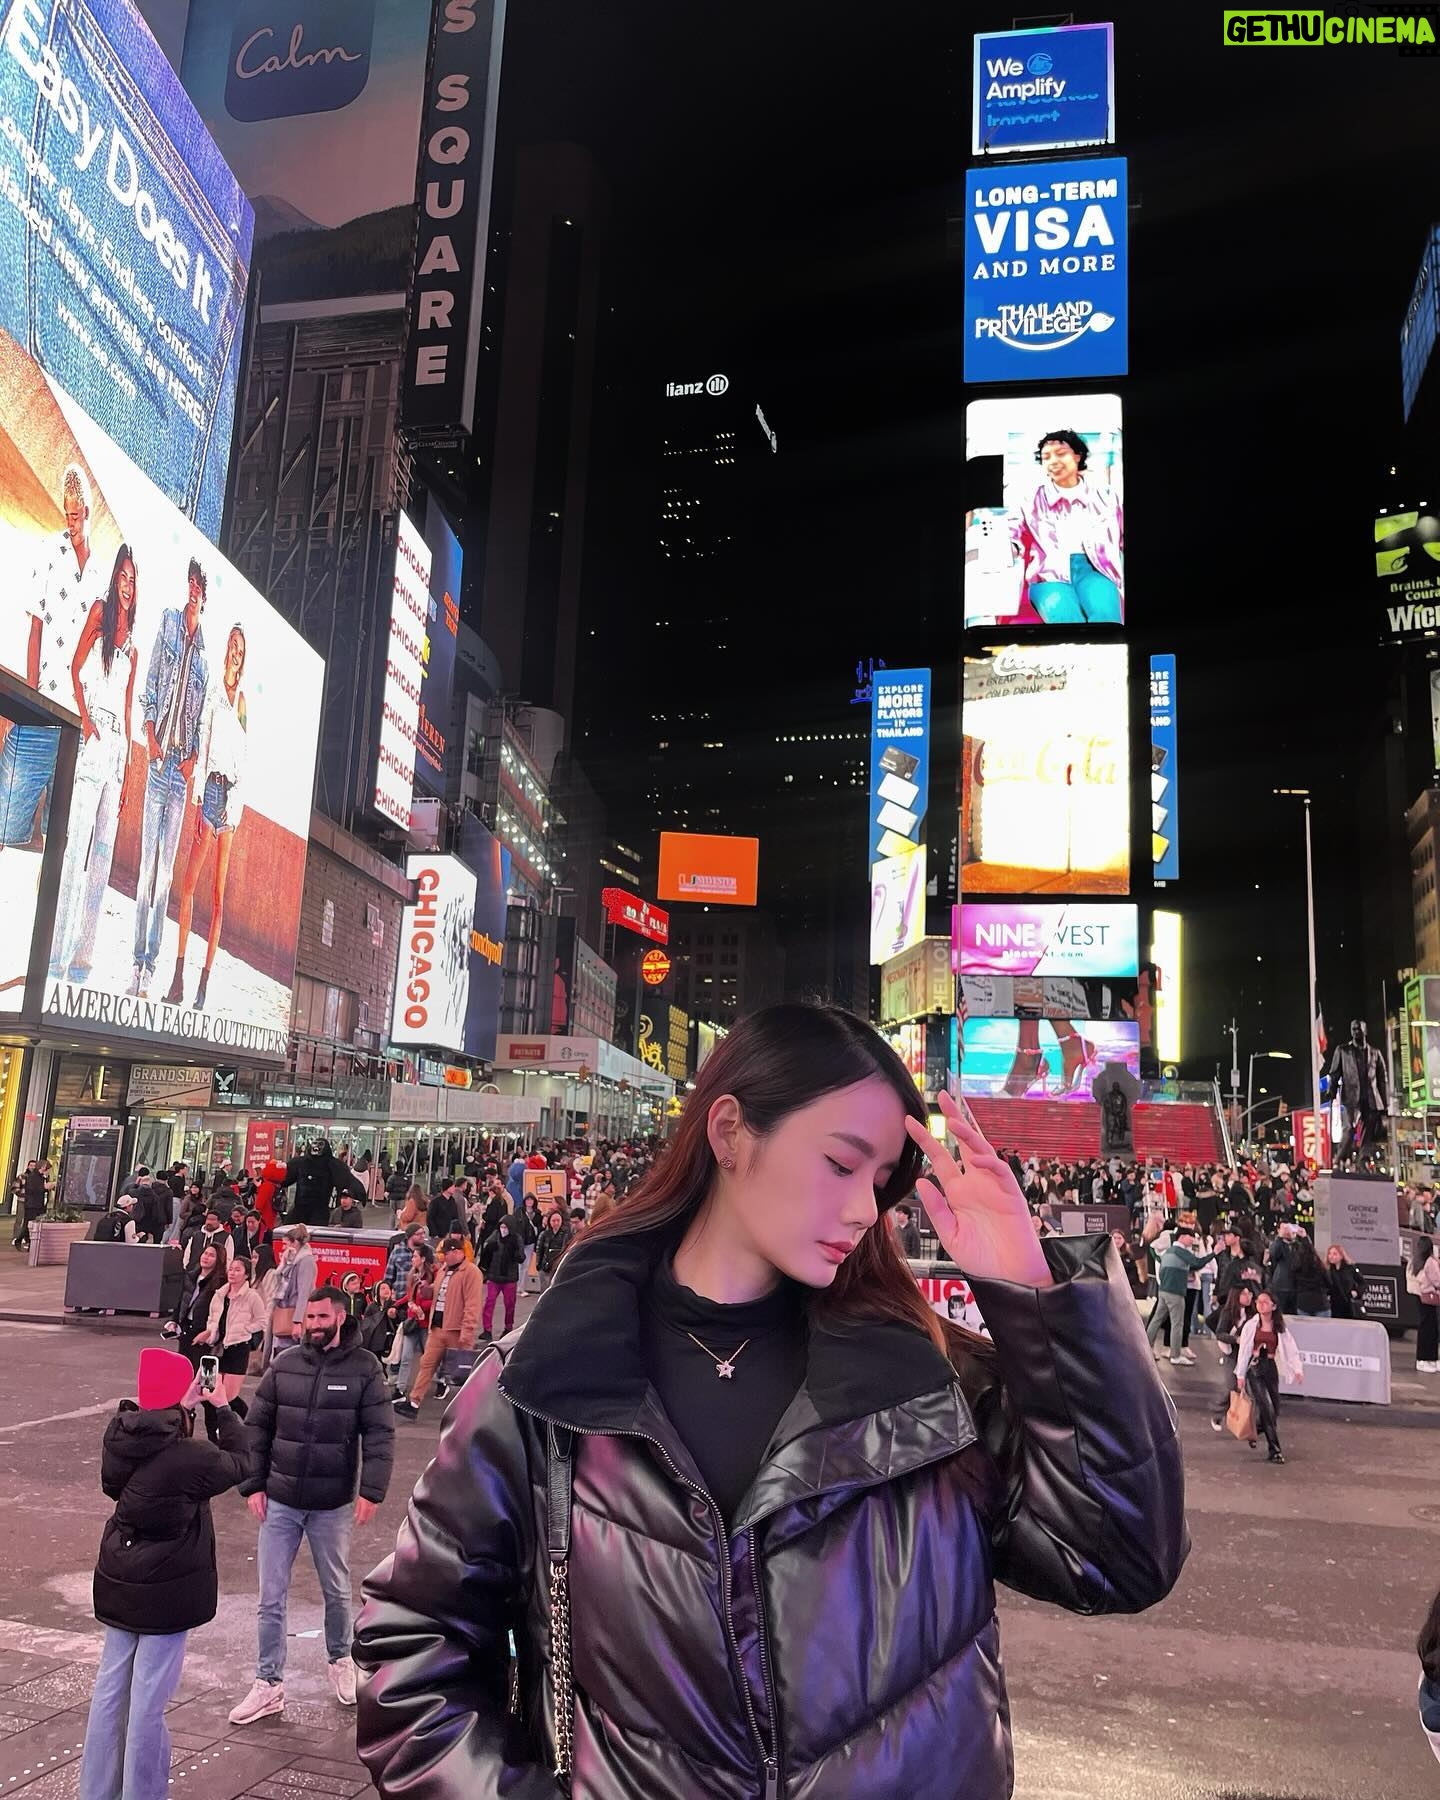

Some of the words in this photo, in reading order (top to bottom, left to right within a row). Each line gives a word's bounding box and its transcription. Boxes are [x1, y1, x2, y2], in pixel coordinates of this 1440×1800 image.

[235, 24, 362, 79] Calm
[986, 58, 1024, 78] We
[986, 77, 1066, 101] Amplify
[5, 0, 105, 171] Easy
[105, 122, 191, 291] Does
[192, 252, 214, 326] It
[975, 178, 1118, 208] LONG-TERM
[415, 74, 470, 386] SQUARE
[973, 204, 1115, 254] VISA
[973, 261, 1028, 280] AND
[1039, 254, 1116, 276] MORE
[997, 300, 1093, 322] THAILAND
[975, 315, 1083, 339] PRIVILEGE
[144, 350, 167, 385] are
[877, 684, 924, 695] EXPLORE
[877, 693, 924, 709] MORE
[877, 707, 924, 720] FLAVORS
[894, 719, 906, 728] IN
[876, 726, 924, 739] THAILAND
[975, 922, 1036, 947] NINE
[404, 868, 440, 1030] CHICAGO
[49, 982, 158, 1032] AMERICAN
[162, 1005, 211, 1039] EAGLE
[213, 1017, 288, 1055] OUTFITTERS
[132, 1066, 176, 1082] GRAND
[176, 1068, 212, 1084] SLAM
[1309, 1353, 1363, 1369] SQUARE
